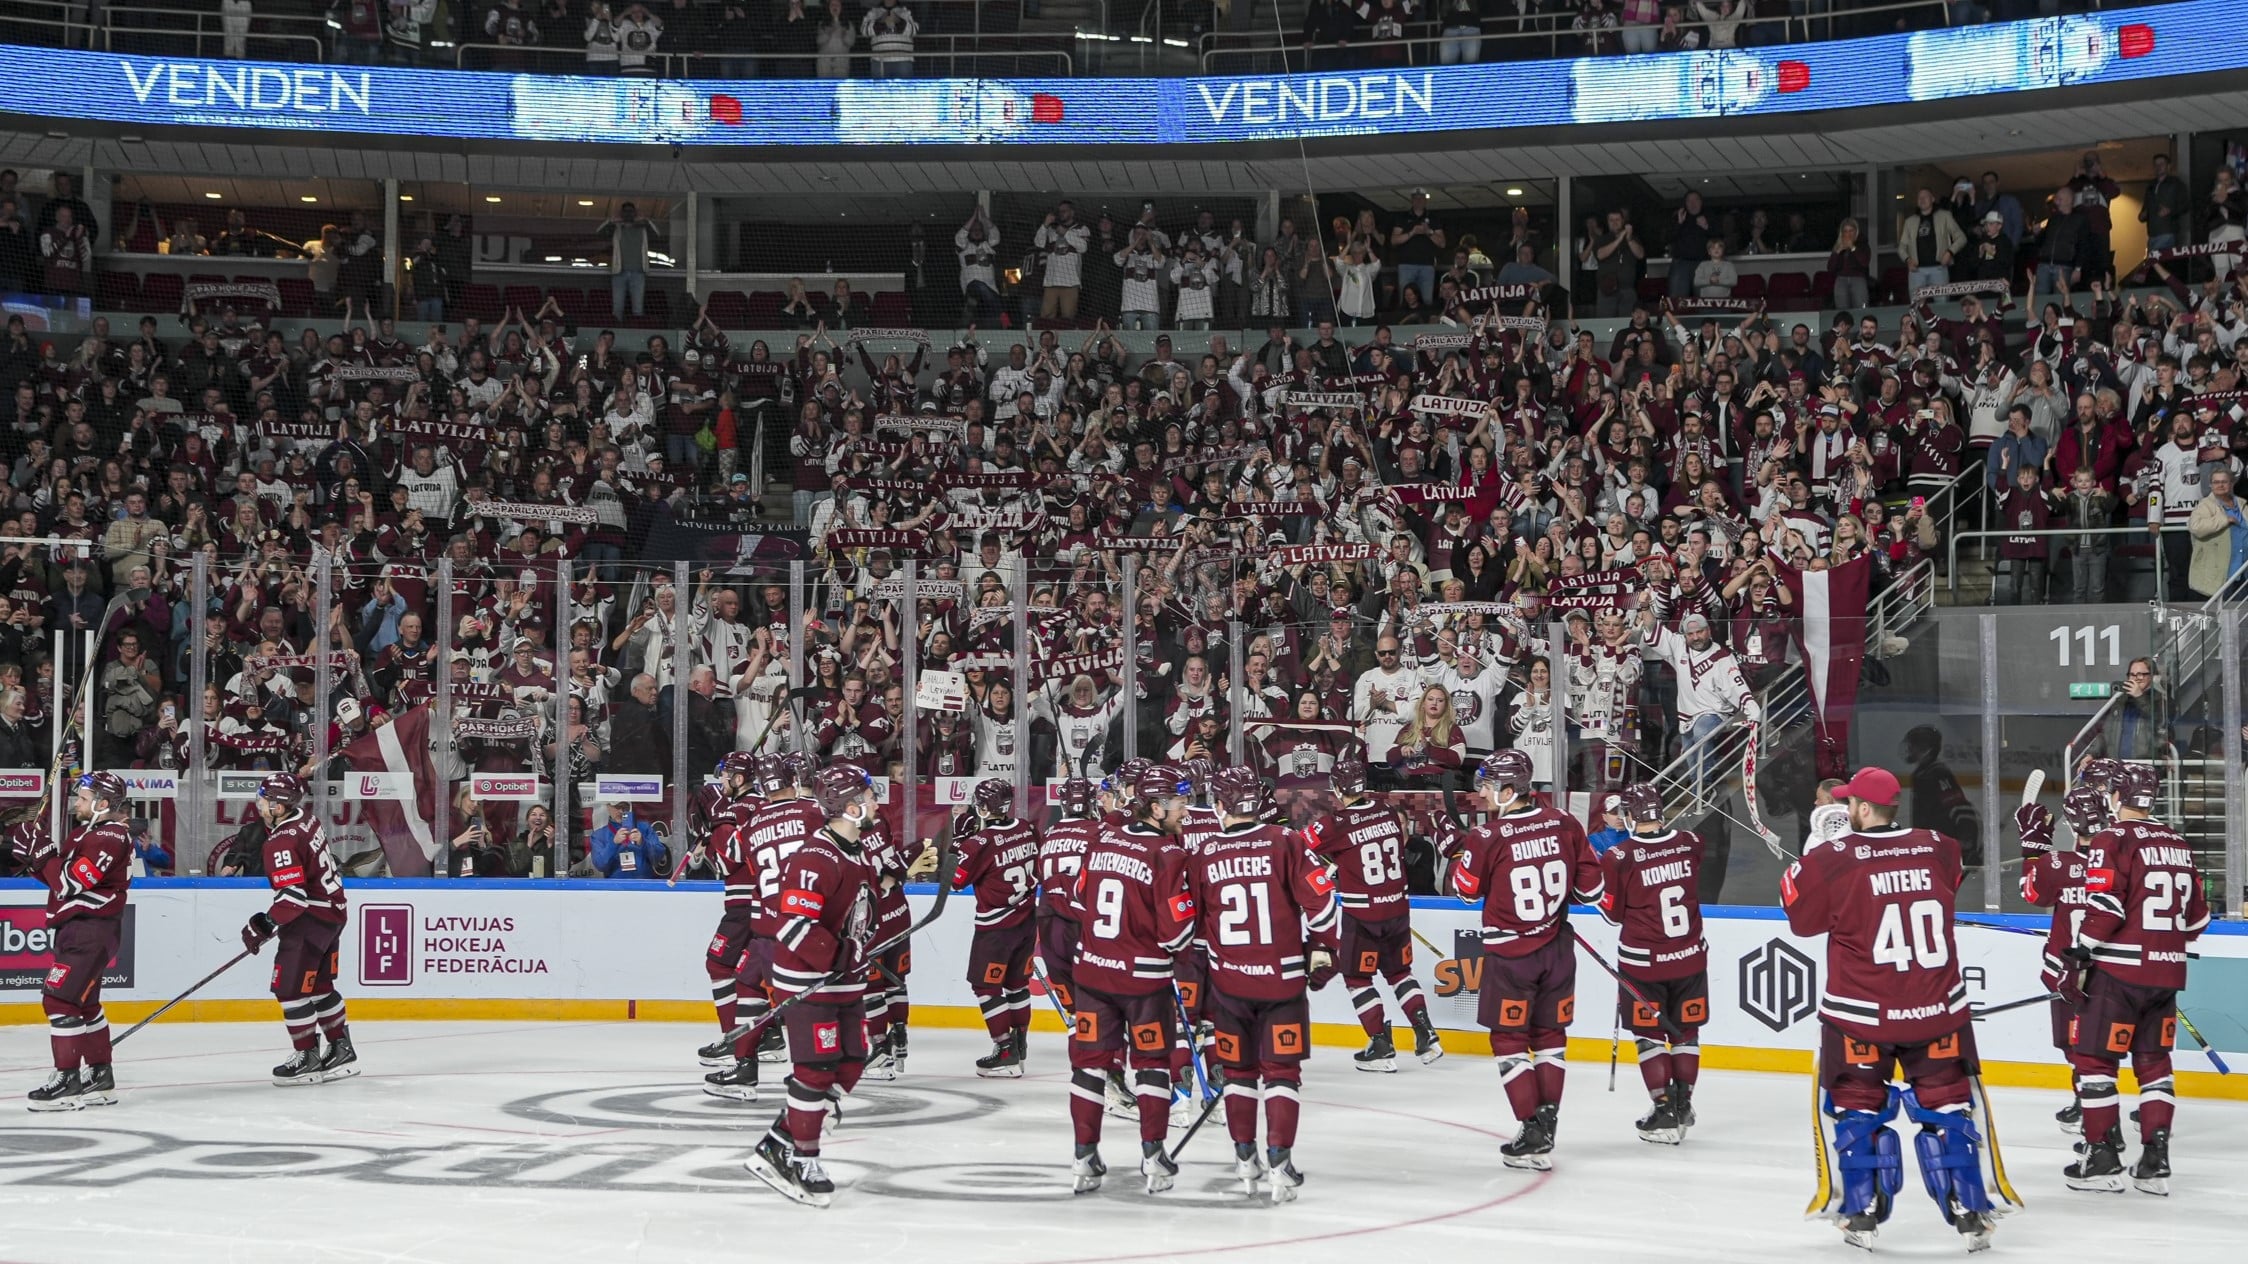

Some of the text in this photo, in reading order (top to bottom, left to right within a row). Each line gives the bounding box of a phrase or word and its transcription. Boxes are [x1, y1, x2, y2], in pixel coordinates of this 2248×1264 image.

[120, 60, 370, 116] VENDEN
[1198, 73, 1434, 125] VENDEN
[2172, 241, 2228, 257] LATVIJA
[1460, 285, 1526, 303] LATVIJA
[1686, 299, 1748, 309] LATVIJA
[1335, 373, 1385, 387] LATVIJA
[1422, 397, 1490, 414] LATVIJA
[271, 423, 332, 437] LATVIJA
[394, 419, 486, 440] LATVIJA
[1919, 437, 1949, 471] ATVIJA
[869, 479, 924, 491] LATVIJA
[946, 474, 1018, 485] LATVIJA
[1422, 486, 1477, 500] LATVIJA
[500, 505, 571, 517] PAR LATVIJU
[1240, 503, 1304, 515] LATVIJA
[675, 519, 733, 532] LATVIETIS
[953, 513, 1024, 528] LATVIJA
[836, 530, 909, 544] LATVIJA
[1103, 537, 1179, 549] LATVIJA
[1291, 544, 1371, 561] LATVIJA
[1559, 571, 1621, 588] LATVIJA
[1551, 597, 1615, 608] LATVIJA
[2050, 624, 2121, 667] 111
[1042, 648, 1125, 677] LATVIJA
[428, 682, 501, 698] LTVIJA
[459, 724, 487, 734] PAR
[208, 727, 290, 749] LATVIJA
[988, 761, 1015, 772] LATVI
[126, 778, 175, 790] AXIMA
[495, 781, 529, 793] Optibet
[1514, 819, 1561, 835] Latvijas gāze
[1217, 839, 1272, 853] Latvijas gāze
[1511, 835, 1561, 862] BUNCIS
[1647, 845, 1692, 861] Latvijas gāze
[1873, 844, 1934, 859] Latvijas gāze
[96, 850, 114, 873] 73
[274, 850, 293, 868] 29
[1359, 837, 1403, 886] 83
[1207, 855, 1272, 885] BALCERS
[1641, 858, 1693, 887] KOMULS
[800, 869, 819, 891] 17
[1869, 868, 1932, 896] MITENS
[1509, 859, 1568, 922] 89
[1093, 878, 1125, 940] 9
[2142, 870, 2193, 932] 23
[1218, 881, 1273, 946] 21
[1659, 885, 1691, 938] 6
[425, 916, 515, 932] LATVIJAS
[0, 920, 56, 951] bet
[1873, 900, 1949, 972] 40
[425, 937, 507, 953] HOKEJA
[1656, 943, 1701, 963] MAXIMA
[425, 955, 549, 974] FEDERĀCIJA
[1083, 951, 1127, 971] MAXIMA
[101, 976, 129, 988] gov.lv
[1887, 1002, 1947, 1021] MAXIMA
